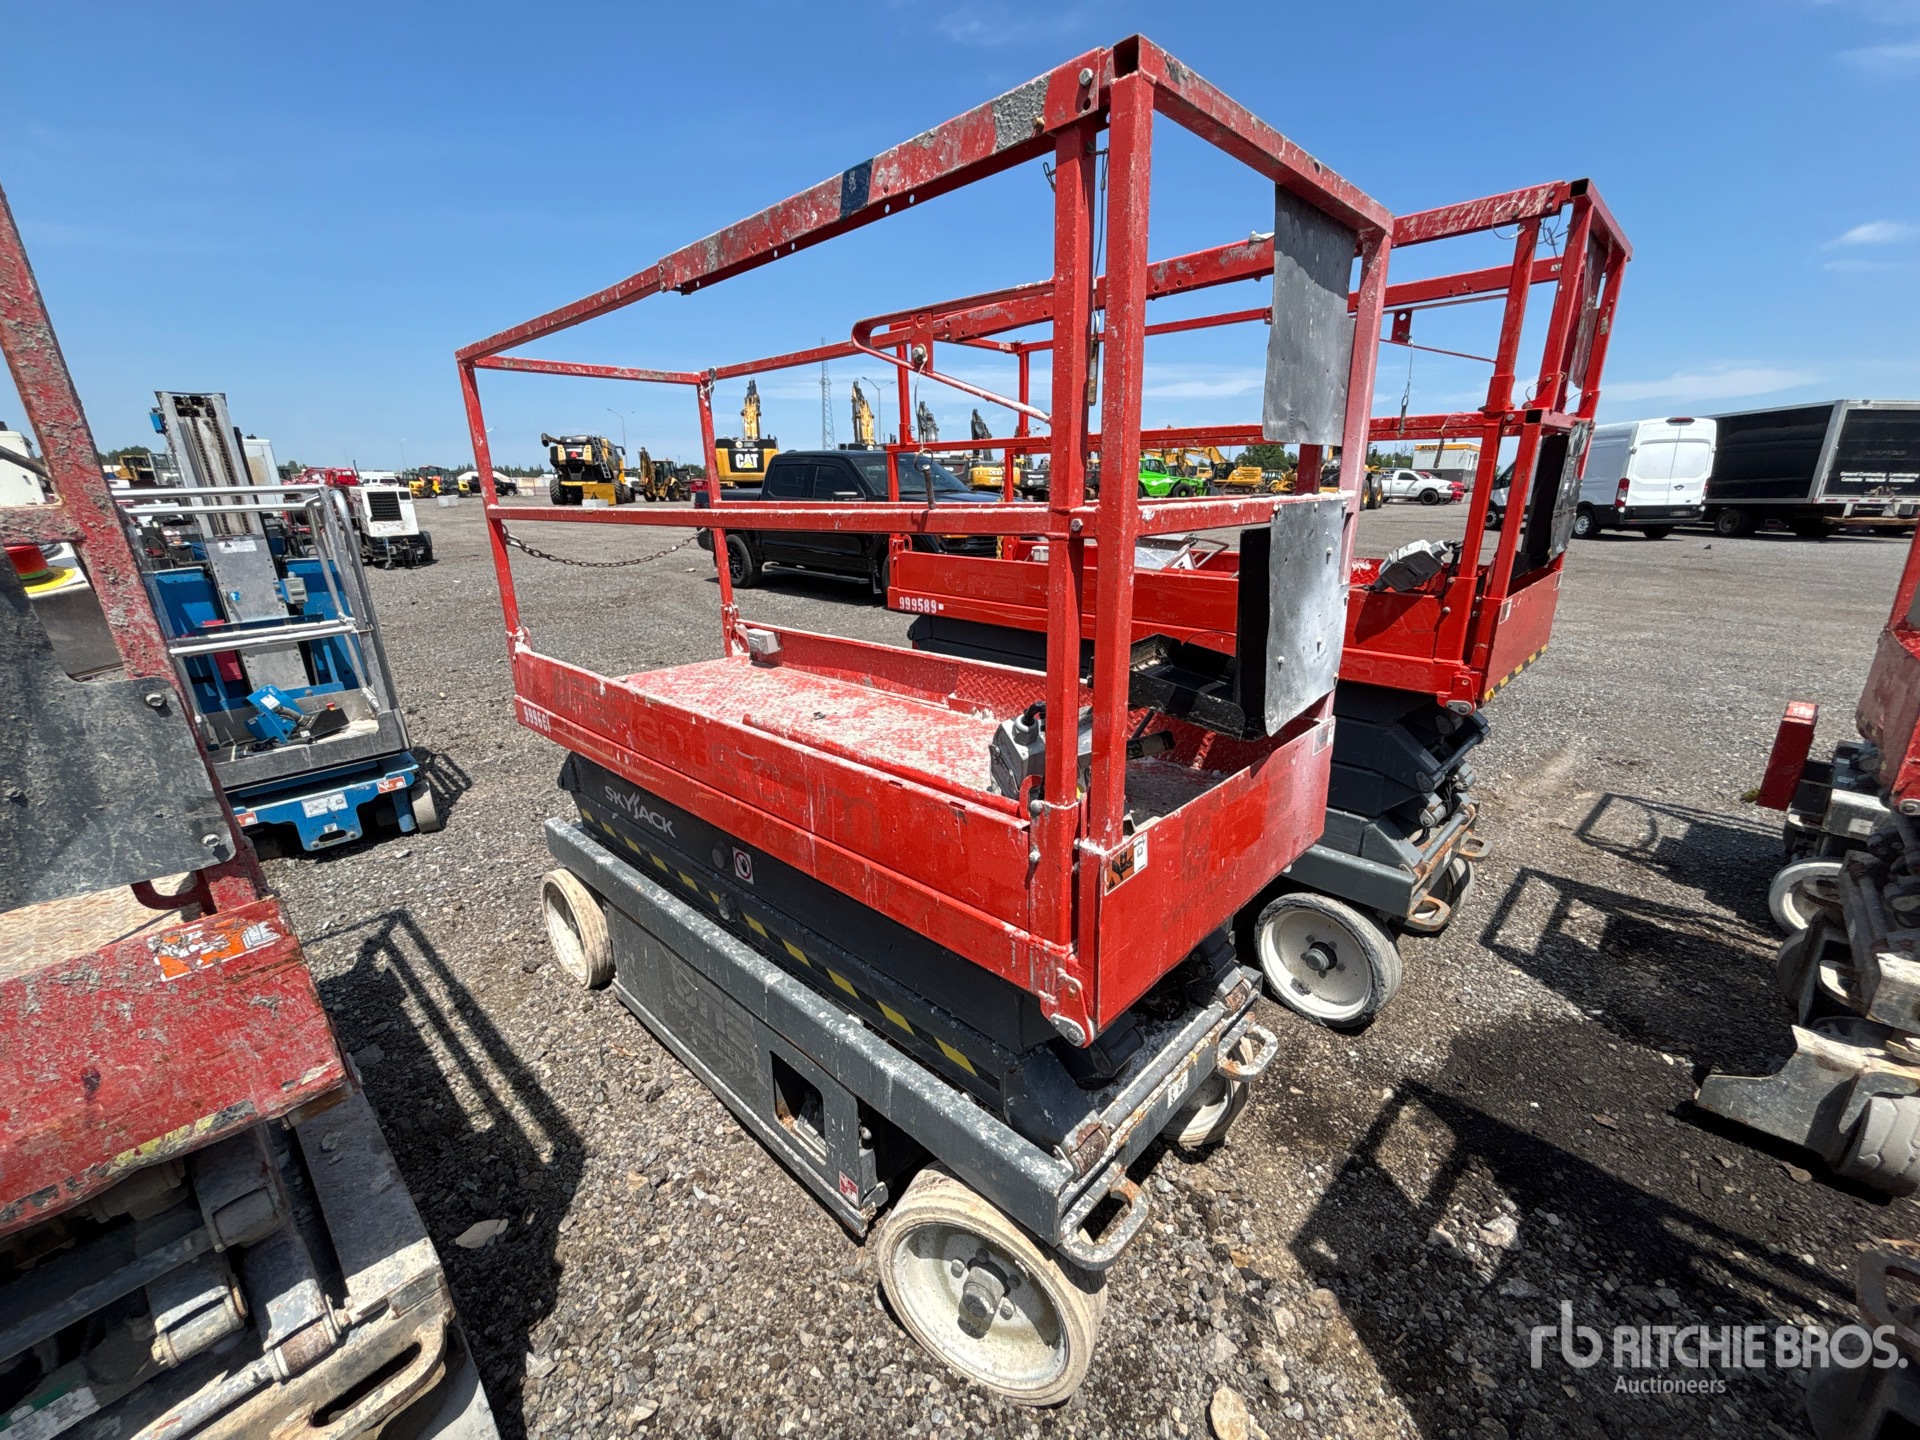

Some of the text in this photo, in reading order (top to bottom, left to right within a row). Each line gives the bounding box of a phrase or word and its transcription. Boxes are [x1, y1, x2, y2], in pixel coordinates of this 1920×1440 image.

[735, 453, 759, 469] CAT
[899, 596, 937, 614] 999589
[604, 785, 677, 839] SKYJACK
